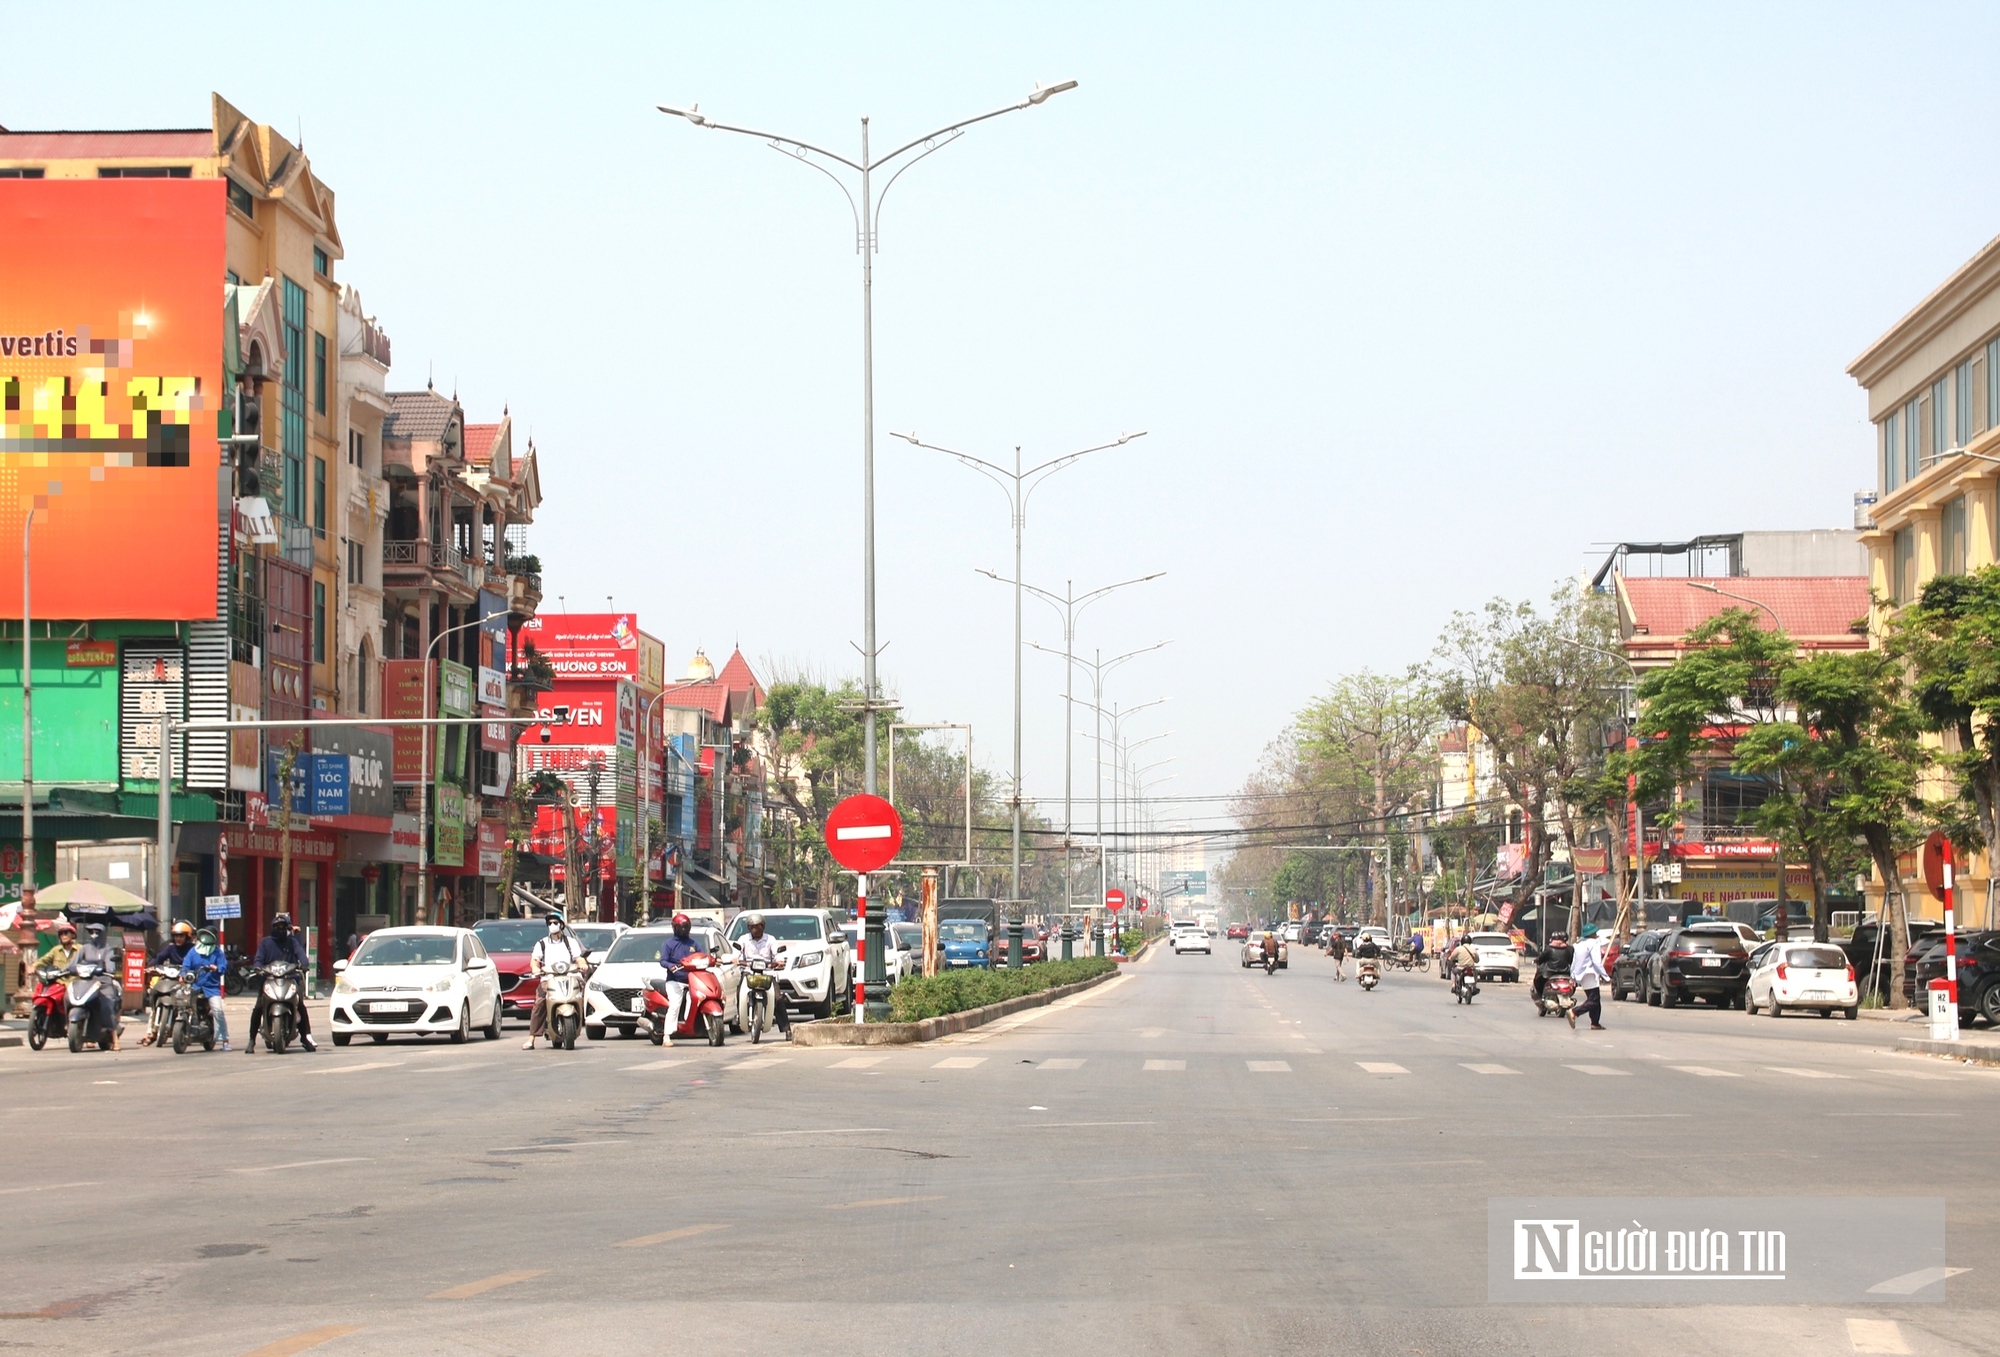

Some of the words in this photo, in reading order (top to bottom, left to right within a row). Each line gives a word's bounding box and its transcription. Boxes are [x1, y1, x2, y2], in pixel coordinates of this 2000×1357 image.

[414, 665, 425, 674] VẤ
[600, 660, 627, 673] SƠN
[531, 708, 603, 726] SVEN
[319, 771, 342, 783] TÓC
[318, 788, 343, 798] NAM
[1704, 845, 1722, 854] 211
[1725, 846, 1748, 854] PHAN
[1750, 844, 1773, 854] ĐÌNH
[127, 958, 143, 967] THAY
[128, 968, 141, 977] PIN
[1937, 993, 1946, 1002] H2
[1937, 1004, 1946, 1013] 14
